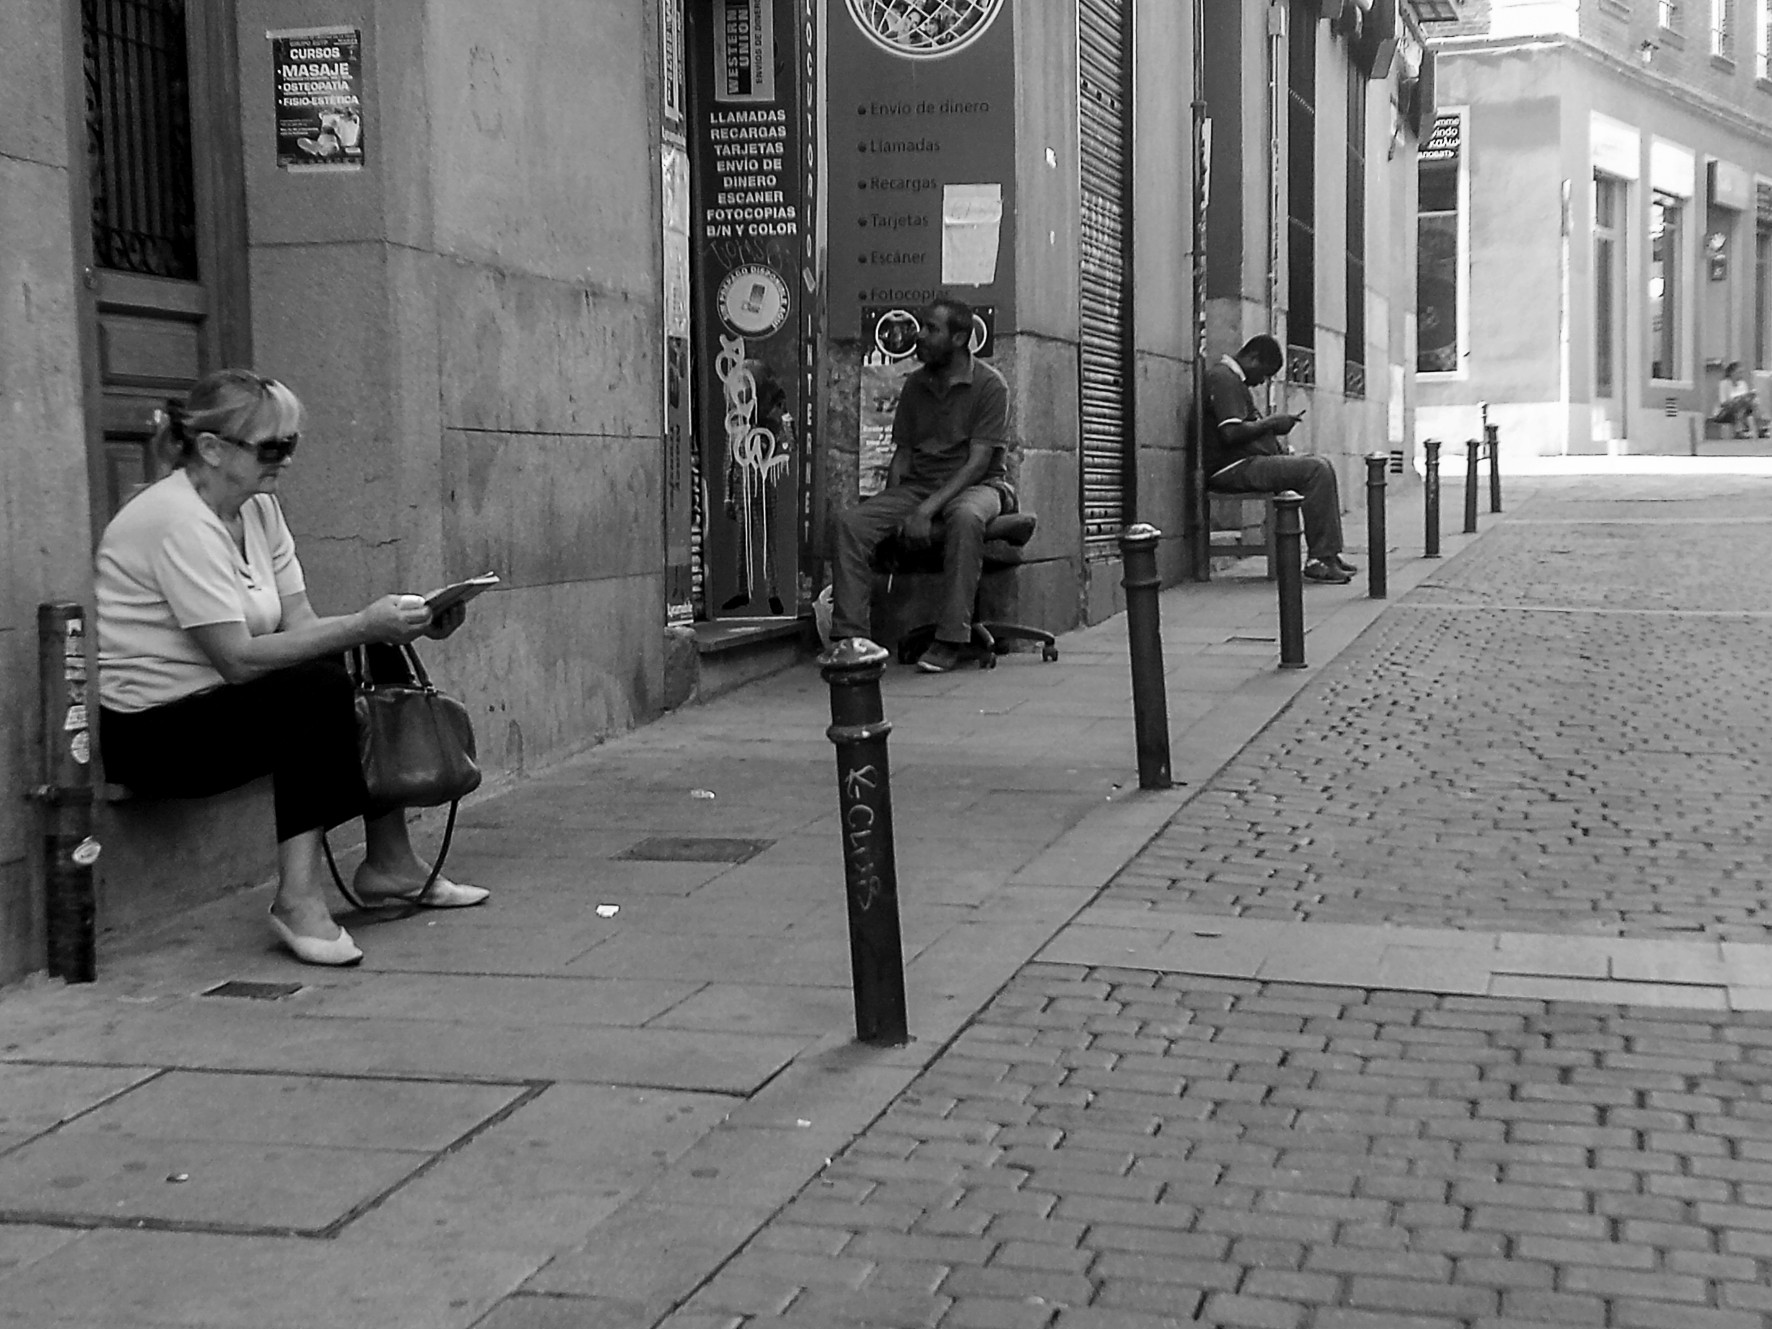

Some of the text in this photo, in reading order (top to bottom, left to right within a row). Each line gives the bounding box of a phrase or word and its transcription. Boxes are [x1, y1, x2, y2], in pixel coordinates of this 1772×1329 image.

[738, 9, 749, 67] UNION
[754, 33, 762, 46] DE
[289, 46, 341, 60] CURSOS
[726, 9, 740, 94] WESTERN
[282, 62, 349, 77] MASAJE
[916, 100, 935, 114] de
[940, 100, 989, 114] dinero
[710, 109, 786, 124] LLAMADAS
[710, 125, 787, 140] RECARGAS
[713, 141, 784, 156] TARJETAS
[870, 138, 940, 153] Llamadas
[717, 156, 782, 172] ENVÍO DE
[723, 174, 777, 189] DINERO
[870, 177, 937, 192] Recargas
[706, 205, 796, 221] FOTOCOPIAS
[871, 212, 929, 230] Tarjetas
[706, 222, 797, 237] B/N Y COLOR
